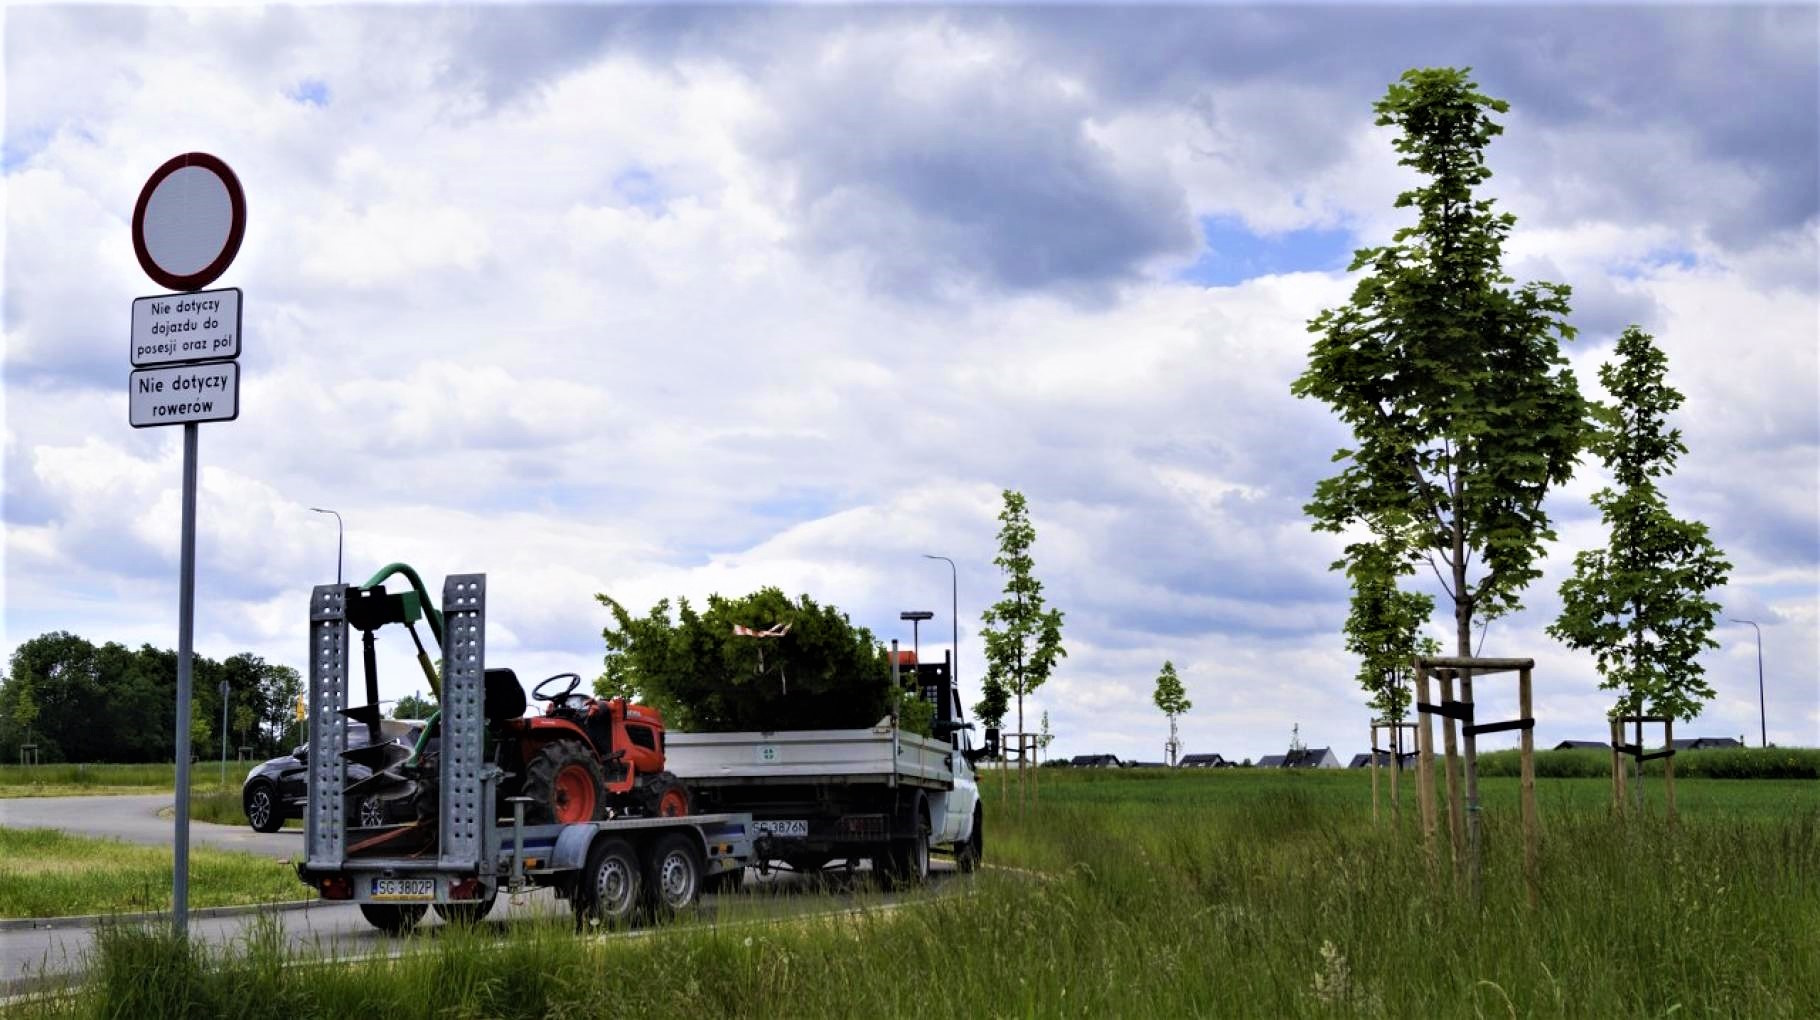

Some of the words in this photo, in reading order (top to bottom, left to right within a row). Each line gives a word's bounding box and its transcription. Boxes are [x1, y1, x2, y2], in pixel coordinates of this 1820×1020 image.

[151, 302, 171, 315] Nie
[176, 299, 219, 315] dotyczy
[151, 318, 197, 336] dojazdu
[203, 316, 218, 329] do
[137, 339, 177, 358] posesji
[182, 340, 207, 351] oraz
[139, 377, 164, 394] Nie
[172, 375, 228, 393] dotyczy
[152, 397, 213, 416] rowerów
[379, 880, 395, 895] SG
[398, 880, 433, 895] 3802P
